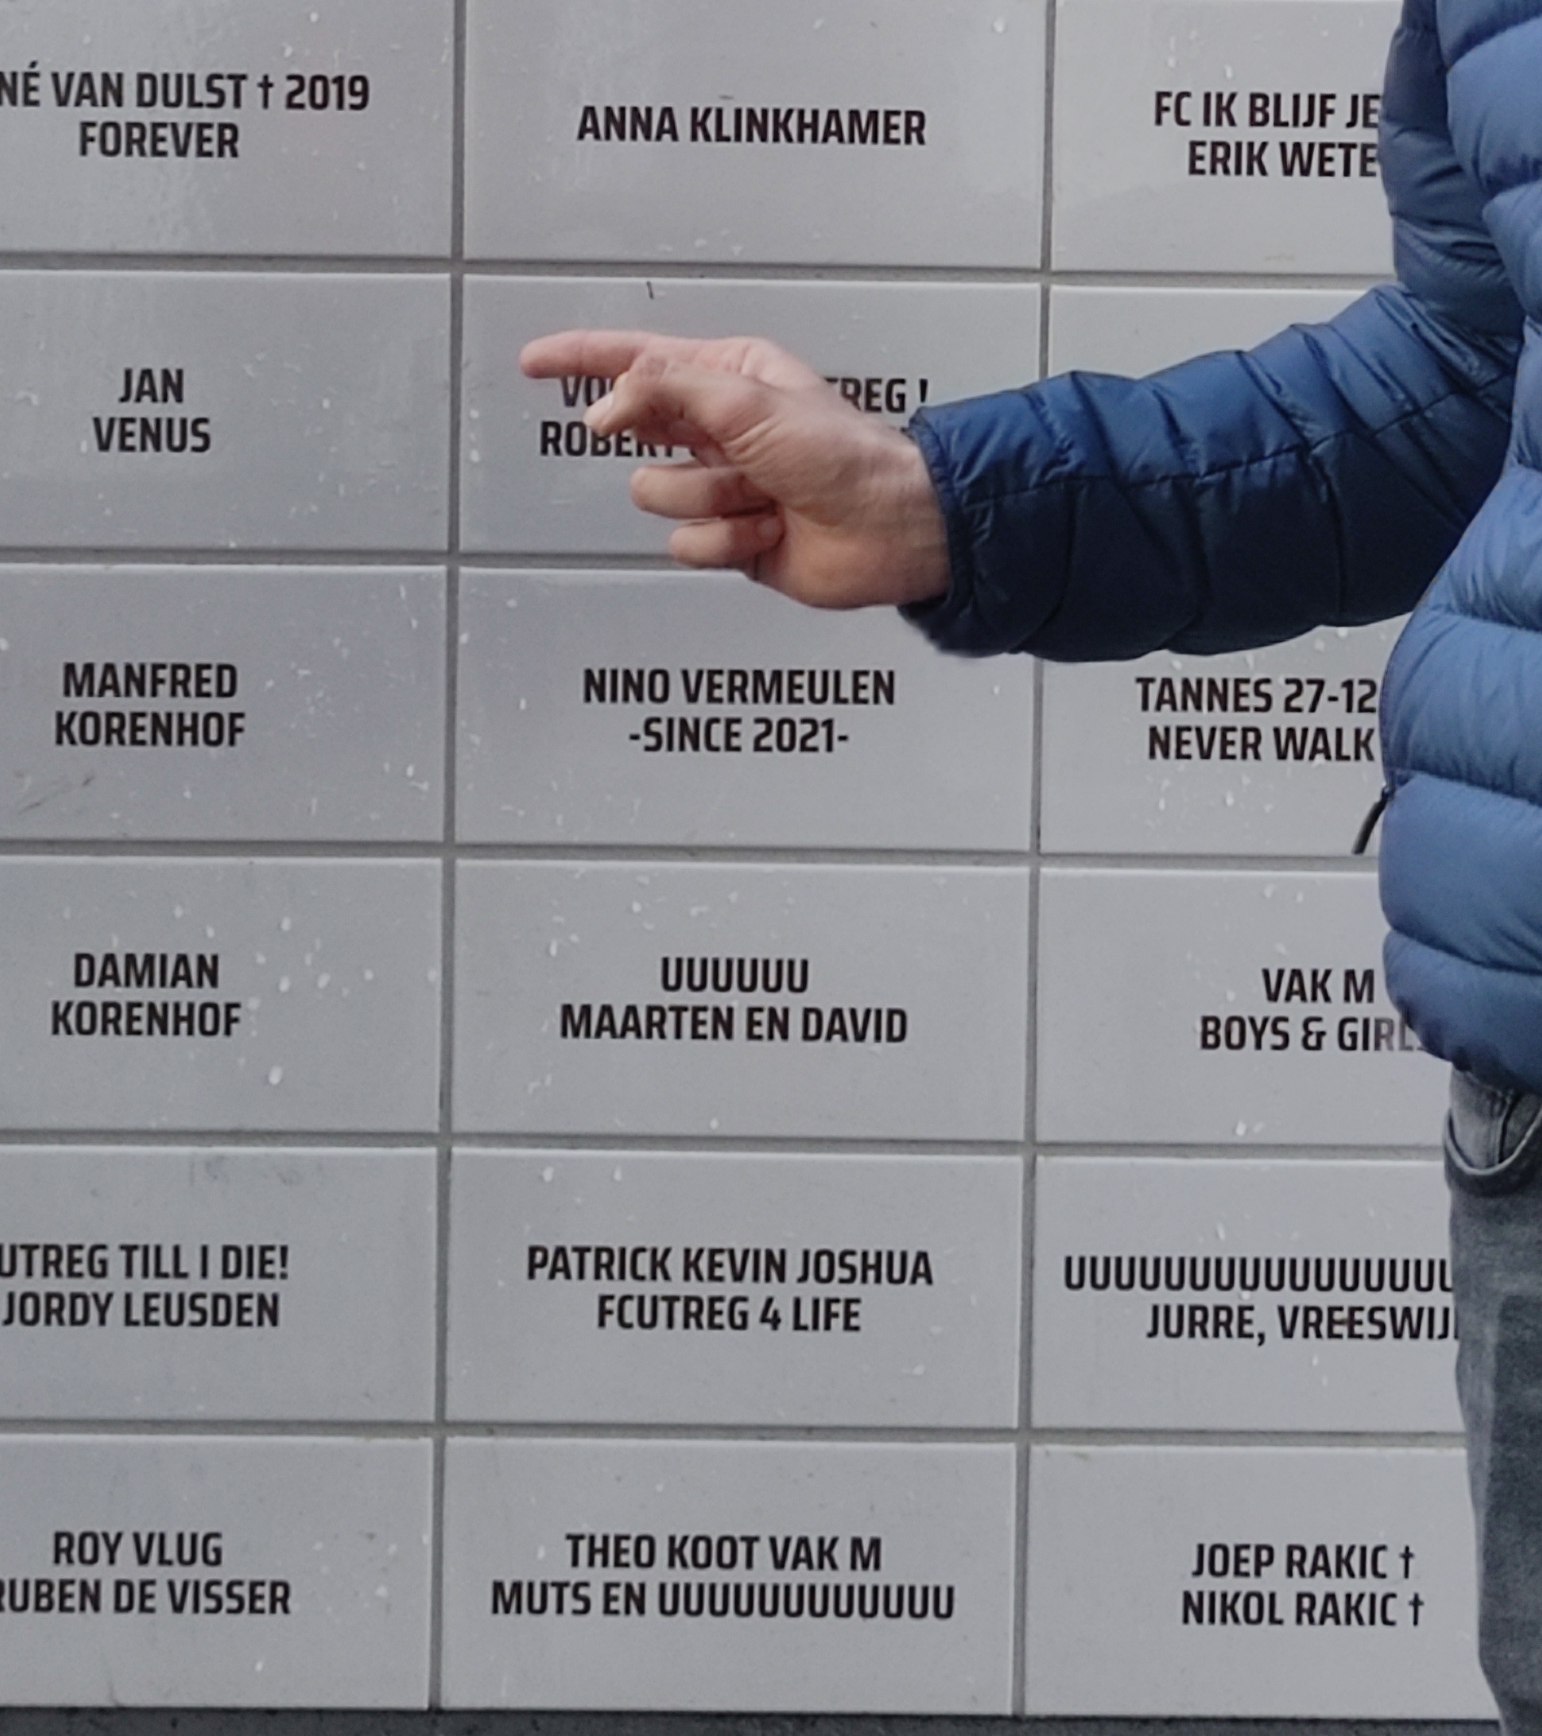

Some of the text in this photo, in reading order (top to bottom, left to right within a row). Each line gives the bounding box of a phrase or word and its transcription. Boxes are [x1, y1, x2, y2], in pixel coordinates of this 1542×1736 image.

[51, 72, 124, 108] VAN
[136, 72, 248, 109] DULST
[285, 74, 369, 111] 2019
[80, 121, 239, 158] FOREVER
[577, 106, 925, 145] ANNA KLINKHAMER
[1189, 140, 1268, 176] ERIK
[119, 368, 183, 404] JAN
[93, 417, 211, 453] VENUS
[63, 662, 237, 698] MANFRED
[584, 668, 894, 705] NINO VERMEULEN
[1135, 677, 1273, 713] TANNES
[55, 711, 245, 747] KORENHOF
[1149, 725, 1374, 761] NEVER WALK
[74, 953, 219, 989] DAMIAN
[661, 957, 808, 993] UUUUUU
[52, 1000, 241, 1037] KORENHOF
[560, 1004, 907, 1043] MAARTEN EN DAVID
[1201, 1016, 1327, 1051] BOYS &
[528, 1245, 933, 1286] PATRICK KEVIN JOSHUA
[2, 1291, 279, 1327] JORDY LEUSDEN
[1147, 1304, 1265, 1346] JURRE,
[53, 1531, 222, 1567] ROY VLUG
[565, 1533, 881, 1571] THEO KOOT VAK M
[1192, 1543, 1388, 1579] JOEP RAKIC
[114, 1579, 156, 1614] DE
[167, 1579, 290, 1615] VISSER
[1183, 1590, 1397, 1626] NIKOL RAKIC
